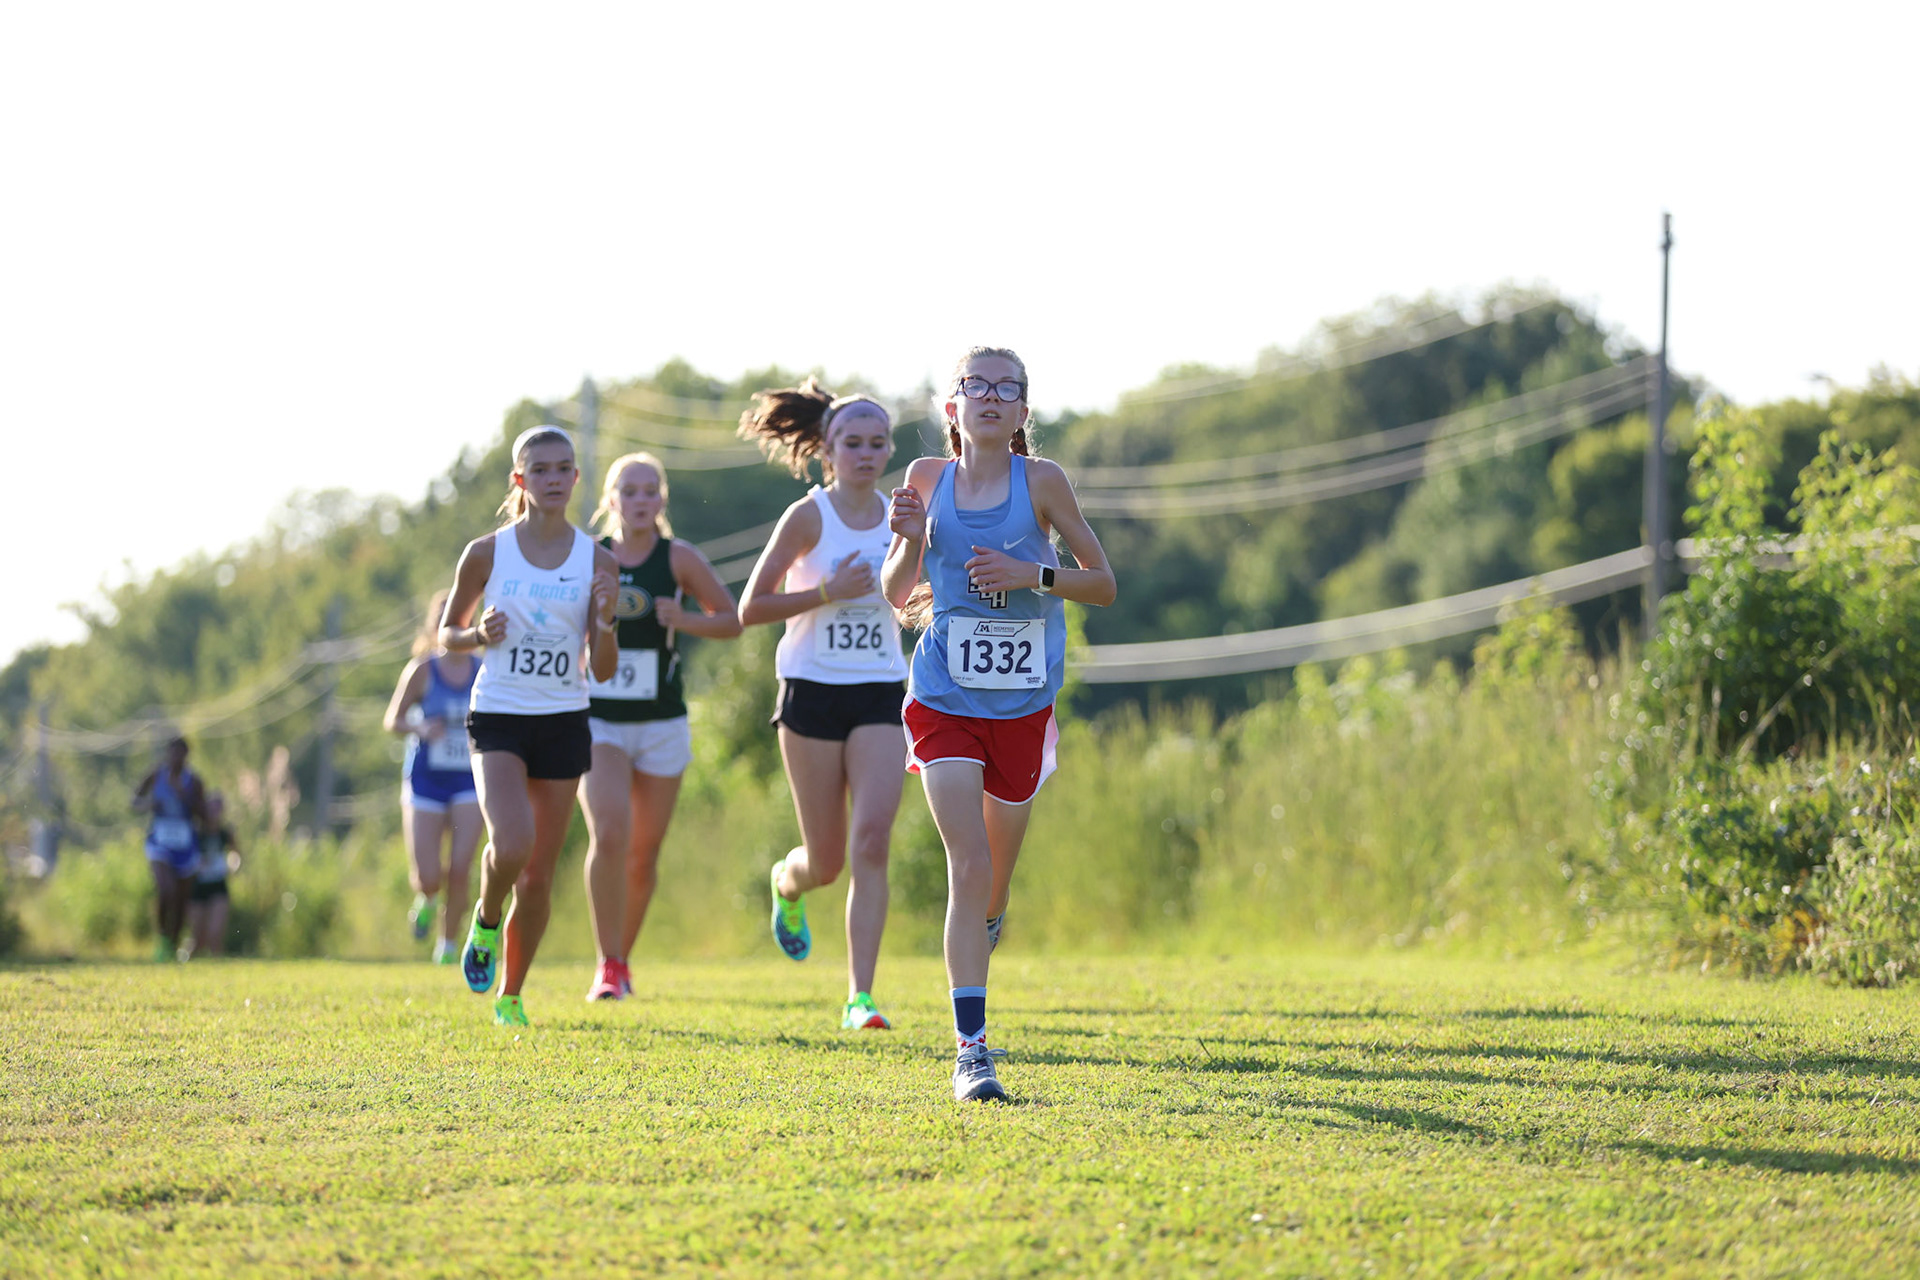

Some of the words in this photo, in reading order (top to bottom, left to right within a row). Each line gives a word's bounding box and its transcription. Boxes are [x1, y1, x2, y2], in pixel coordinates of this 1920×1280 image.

[529, 583, 580, 602] AGNES
[826, 622, 883, 649] 1326
[509, 646, 569, 677] 1320
[960, 639, 1032, 674] 1332
